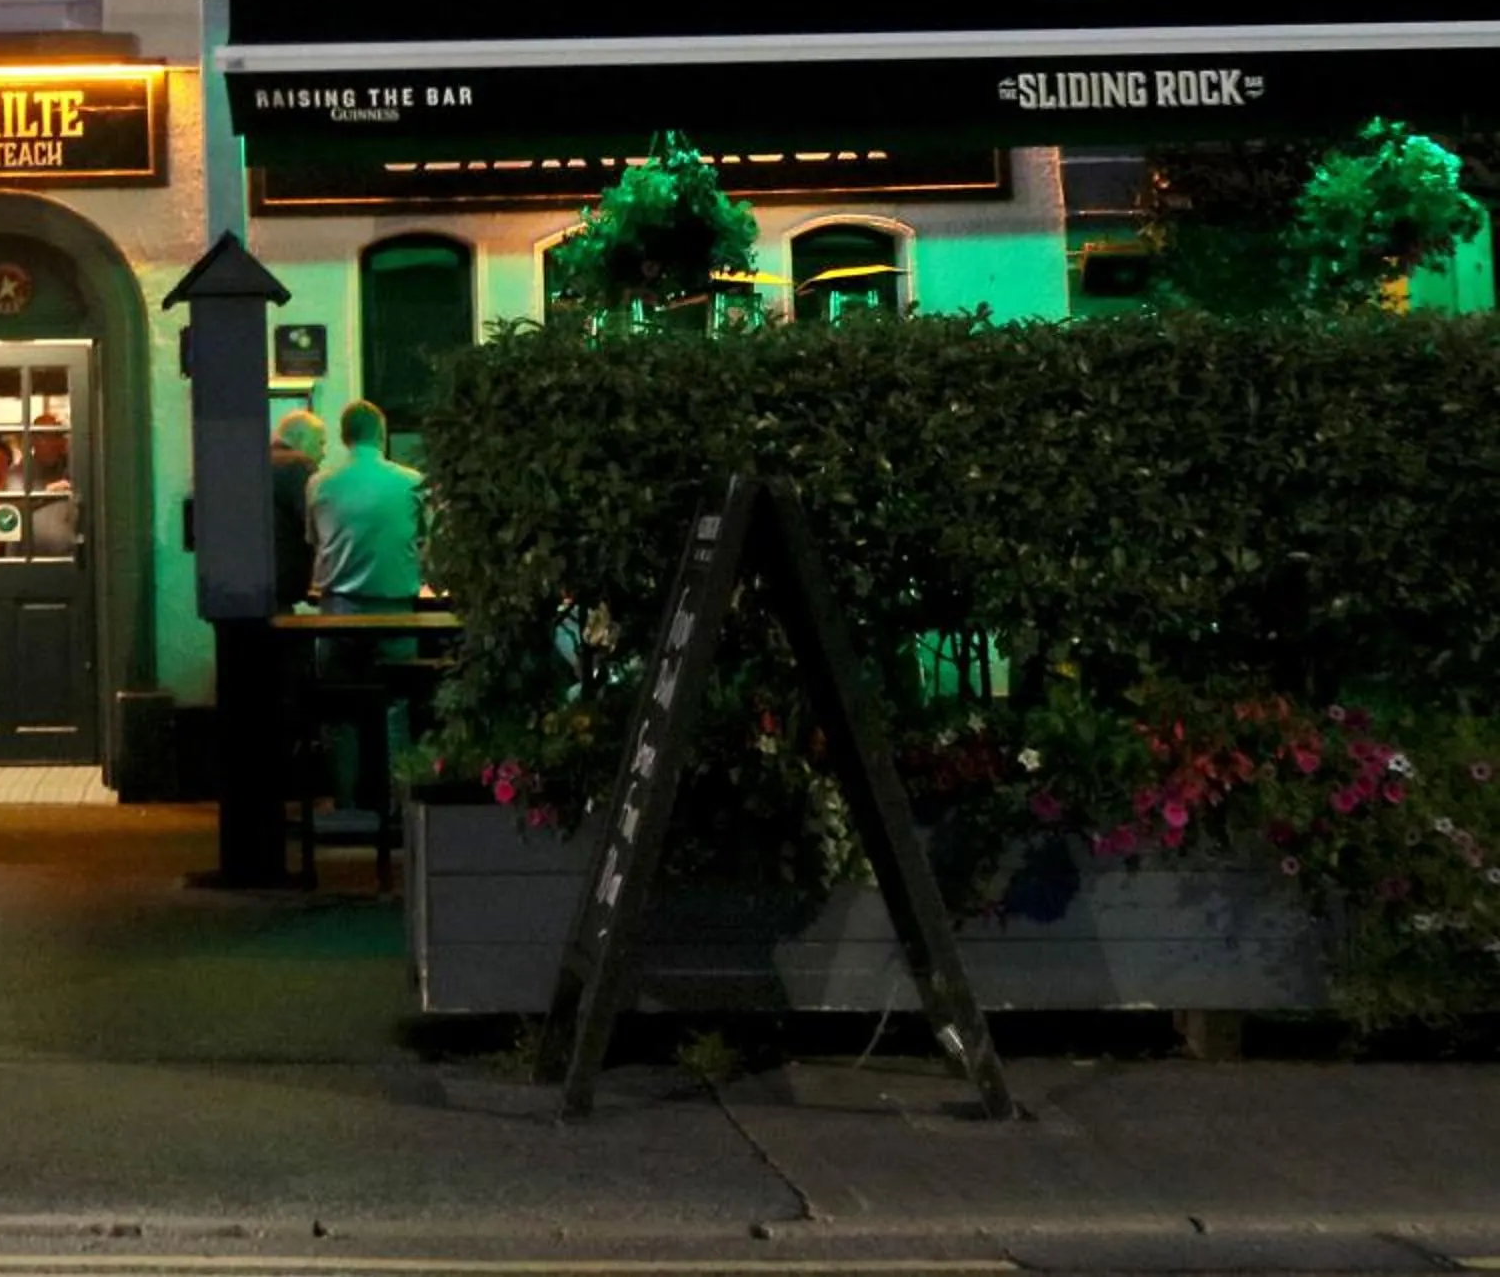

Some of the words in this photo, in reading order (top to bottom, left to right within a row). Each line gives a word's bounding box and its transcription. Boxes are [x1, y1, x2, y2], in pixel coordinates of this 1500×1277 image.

[254, 86, 357, 110] RAISING
[365, 86, 412, 107] THE
[423, 85, 472, 107] BAR
[1016, 71, 1149, 110] SLIDING
[1155, 68, 1247, 107] ROCK
